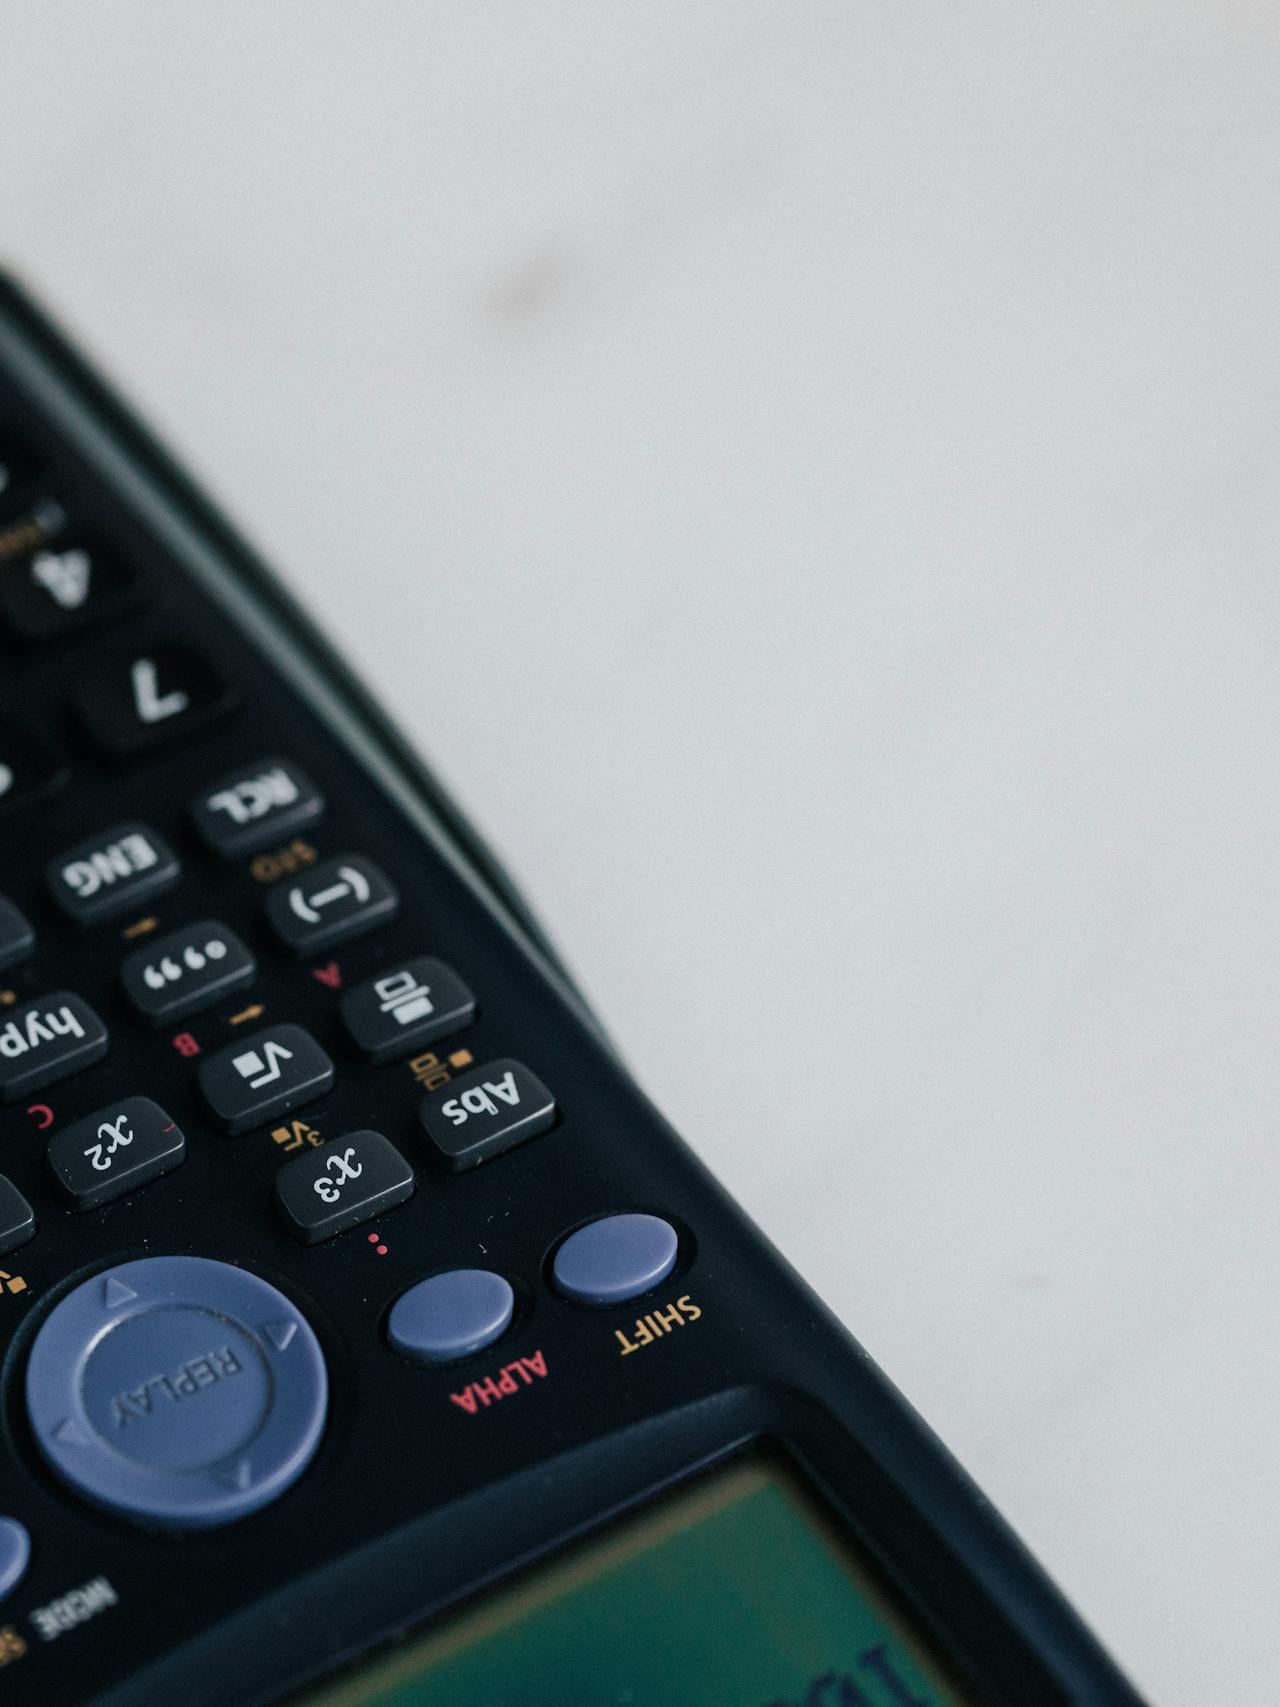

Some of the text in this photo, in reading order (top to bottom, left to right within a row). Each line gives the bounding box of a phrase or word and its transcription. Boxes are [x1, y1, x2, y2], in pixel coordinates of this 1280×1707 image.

[131, 659, 188, 723] 7
[64, 835, 156, 896] ENG
[313, 963, 341, 988] A
[173, 1033, 201, 1058] B
[27, 1104, 54, 1130] C
[442, 1072, 522, 1127] Abs
[614, 1295, 702, 1356] SHIFT
[111, 1346, 241, 1429] REPLAY
[449, 1350, 548, 1413] ALPHA
